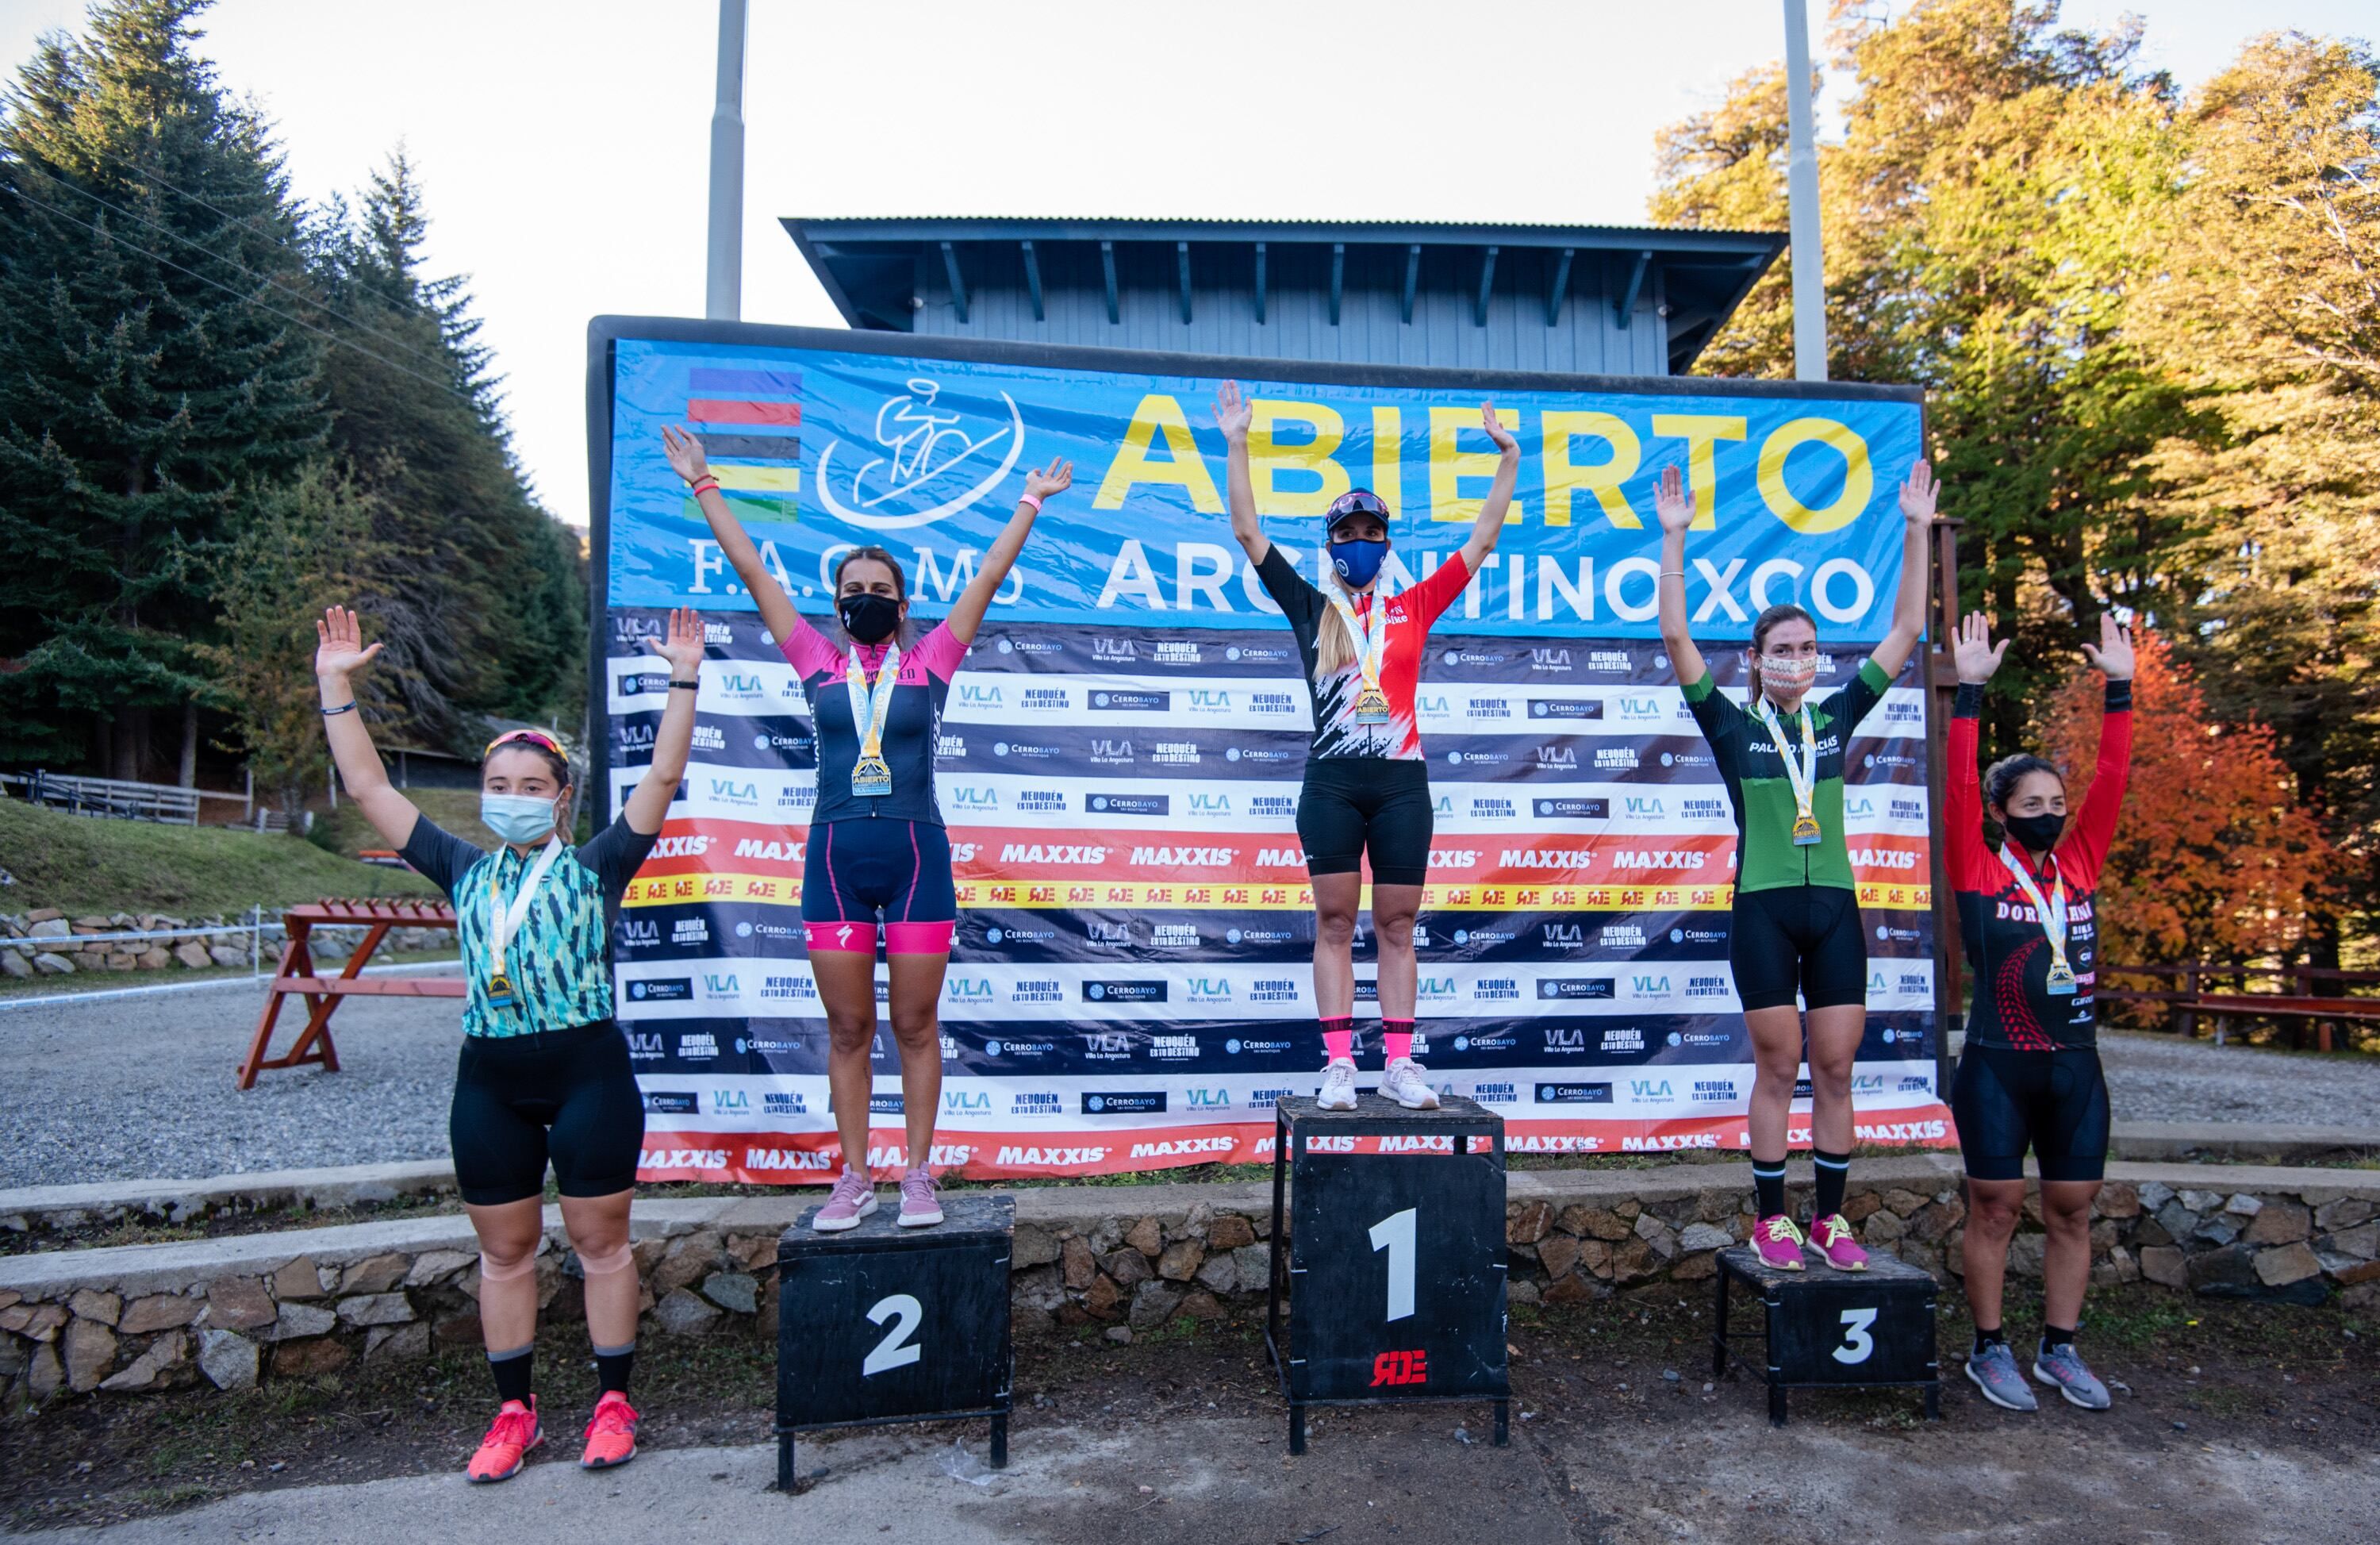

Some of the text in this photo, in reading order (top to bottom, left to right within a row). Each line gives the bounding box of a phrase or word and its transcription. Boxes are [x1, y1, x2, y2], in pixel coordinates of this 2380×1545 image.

[1092, 394, 1873, 534] ABIERTO
[1691, 558, 1874, 624] XCO
[616, 617, 661, 634] VLA
[1015, 641, 1062, 651] CERROBAYO
[1092, 638, 1135, 655] VLA
[1157, 640, 1197, 653] NEUQUÉN
[1242, 648, 1288, 658] CERROBAYO
[1460, 653, 1504, 663] CERROBAYO
[1532, 648, 1571, 664] VLA
[1591, 650, 1628, 662] NEUQUÉN
[722, 675, 762, 690] VLA
[959, 685, 1003, 701] VLA
[1025, 687, 1066, 700] NEUQUÉN
[1111, 694, 1159, 705] CERROBAYO
[1189, 690, 1231, 706] VLA
[1253, 692, 1292, 704] NEUQUÉN
[1469, 698, 1507, 709] NEUQUÉN
[1549, 704, 1595, 713] CERROBAYO
[1620, 698, 1660, 713] VLA
[1011, 744, 1060, 755] CERROBAYO
[1092, 740, 1134, 756] VLA
[1156, 742, 1197, 754] NEUQUÉN
[1242, 750, 1289, 759] CERROBAYO
[1537, 747, 1577, 763] VLA
[1597, 747, 1636, 759] NEUQUÉN
[1464, 752, 1509, 762] CERROBAYO
[711, 779, 758, 799] VLA
[953, 787, 998, 805] VLA
[1021, 789, 1063, 801] NEUQUÉN
[1110, 798, 1158, 809] CERROBAYO
[1188, 794, 1230, 809] VLA
[1253, 795, 1292, 807] NEUQUÉN
[1473, 797, 1512, 809] NEUQUÉN
[1556, 801, 1600, 812] CERROBAYO
[1625, 797, 1664, 813] VLA
[1683, 797, 1722, 810] NEUQUÉN
[647, 836, 708, 859] AXXIS
[1000, 844, 1107, 863] MAXXIS
[1130, 847, 1234, 866] MAXXIS
[1499, 851, 1592, 869] MAXXIS
[1613, 851, 1706, 869] MAXXIS
[624, 920, 658, 939] VLA
[1005, 929, 1054, 940] CERROBAYO
[1087, 923, 1130, 940] VLA
[1154, 923, 1196, 936] NEUQUÉN
[1244, 929, 1292, 940] CERROBAYO
[1469, 931, 1515, 940] CERROBAYO
[1543, 924, 1583, 940] VLA
[1603, 924, 1642, 937] NEUQUÉN
[1685, 930, 1727, 940] CERROBAYO
[647, 983, 684, 993] CERROBAYO
[704, 974, 739, 992] VLA
[766, 976, 812, 989] NEUQUÉN
[948, 978, 993, 996] VLA
[1016, 978, 1059, 992] NEUQUÉN
[1187, 978, 1231, 995] VLA
[1253, 978, 1295, 992] NEUQUÉN
[1477, 978, 1516, 990] NEUQUÉN
[1560, 983, 1606, 993] CERROBAYO
[1633, 976, 1672, 992] VLA
[1690, 975, 1725, 987] NEUQUÉN
[1107, 986, 1157, 995] CERROBAYO
[1154, 1033, 1196, 1047] NEUQUÉN
[1470, 1037, 1516, 1047] CERROBAYO
[1544, 1028, 1585, 1046] VLA
[1604, 1028, 1641, 1042] NEUQUÉN
[1683, 1033, 1730, 1043] CERROBAYO
[747, 1040, 800, 1049] CERROBAYO
[1004, 1042, 1054, 1051] CERROBAYO
[1085, 1034, 1130, 1051] VLA
[1242, 1040, 1292, 1051] CERROBAYO
[1476, 1081, 1514, 1094] NEUQUÉN
[1557, 1087, 1603, 1097] CERROBAYO
[1630, 1080, 1673, 1097] VLA
[1694, 1079, 1734, 1092] NEUQUÉN
[714, 1090, 749, 1108] VLA
[945, 1091, 991, 1109] VLA
[1015, 1091, 1058, 1105] NEUQUÉN
[1106, 1097, 1156, 1106] CERROBAYO
[1186, 1089, 1230, 1105] VLA
[1855, 1120, 1946, 1140] MAXXIS
[1130, 1136, 1234, 1158] MAXXIS
[1505, 1136, 1596, 1151] MAXXIS
[638, 1149, 727, 1169] MAXXIS
[746, 1149, 831, 1170] MAXXIS
[996, 1147, 1105, 1165] MAXXIS
[1368, 1207, 1417, 1323] 1
[862, 1293, 923, 1376] 2
[1832, 1308, 1878, 1365] 3
